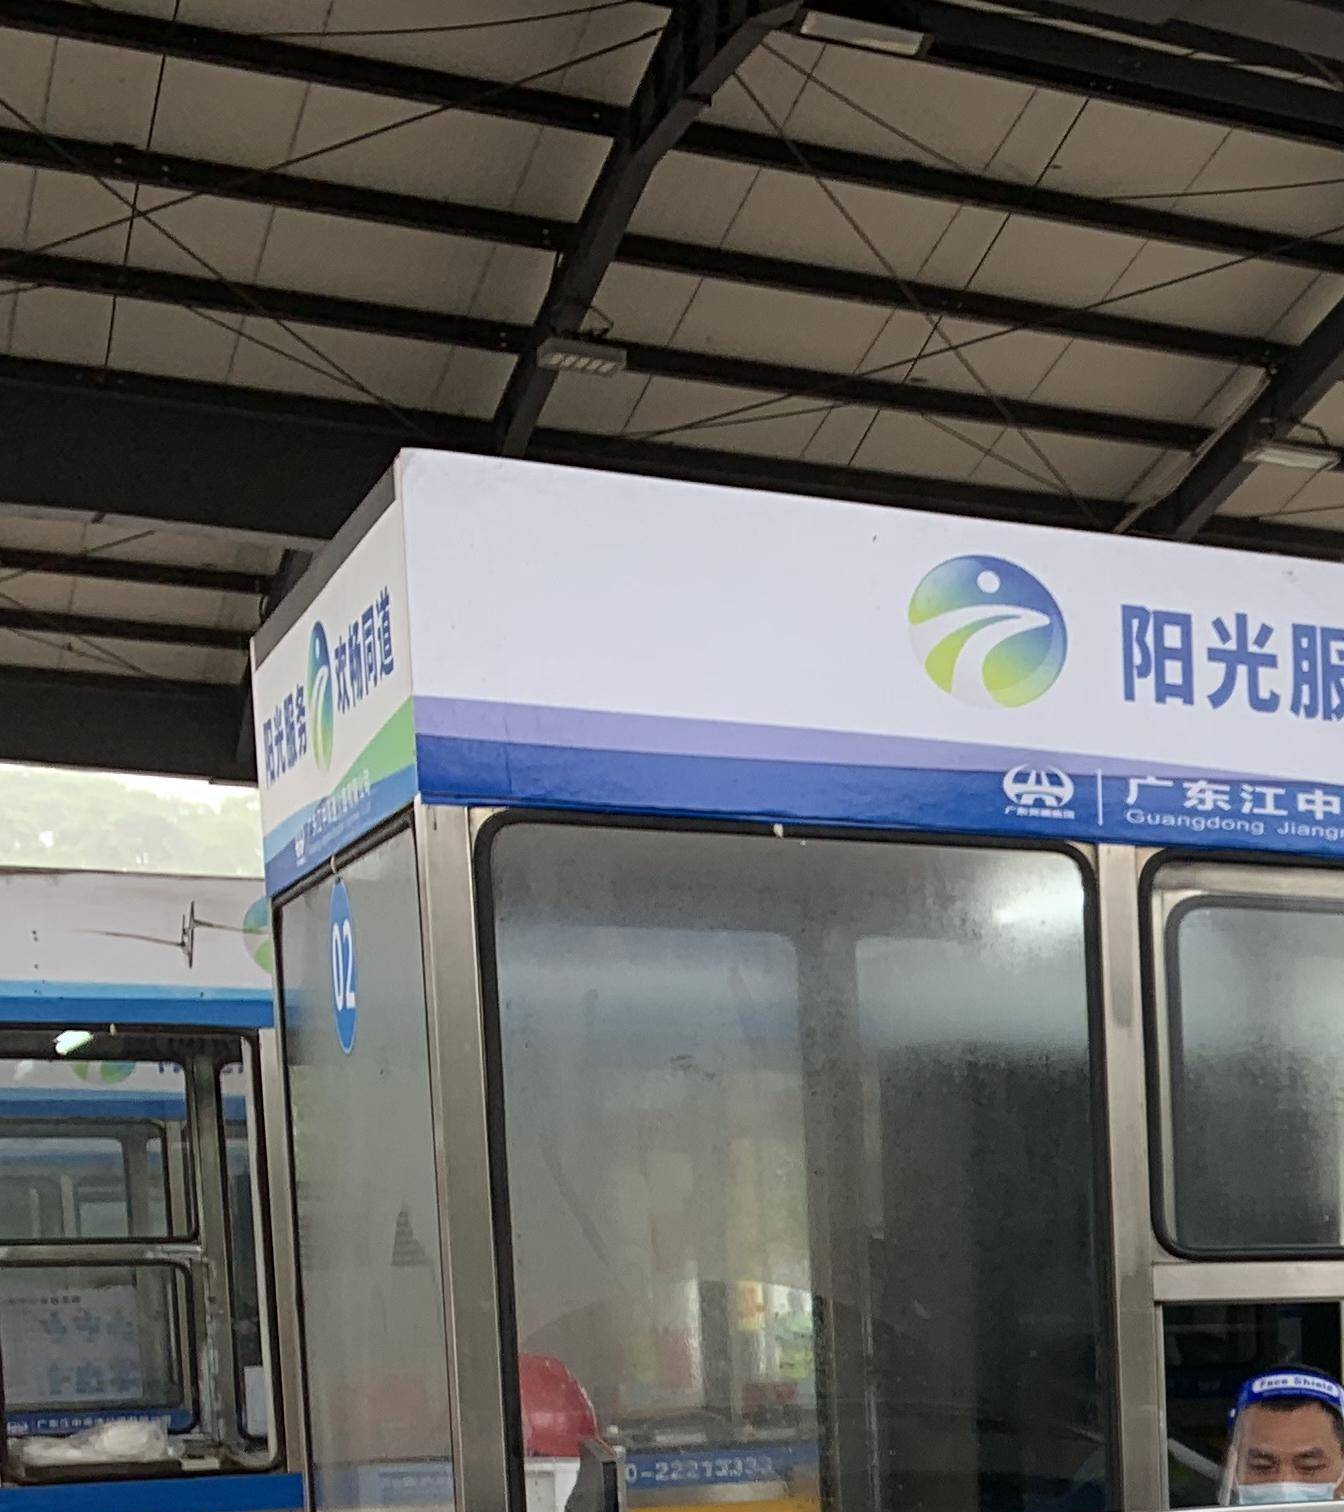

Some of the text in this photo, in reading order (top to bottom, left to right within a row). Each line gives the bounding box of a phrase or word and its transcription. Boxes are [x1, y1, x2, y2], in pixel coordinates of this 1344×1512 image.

[263, 586, 394, 788] 阳光服务 欢畅同道
[1125, 809, 1265, 836] Guangdong
[331, 920, 357, 1010] 02
[1259, 1378, 1289, 1389] Face
